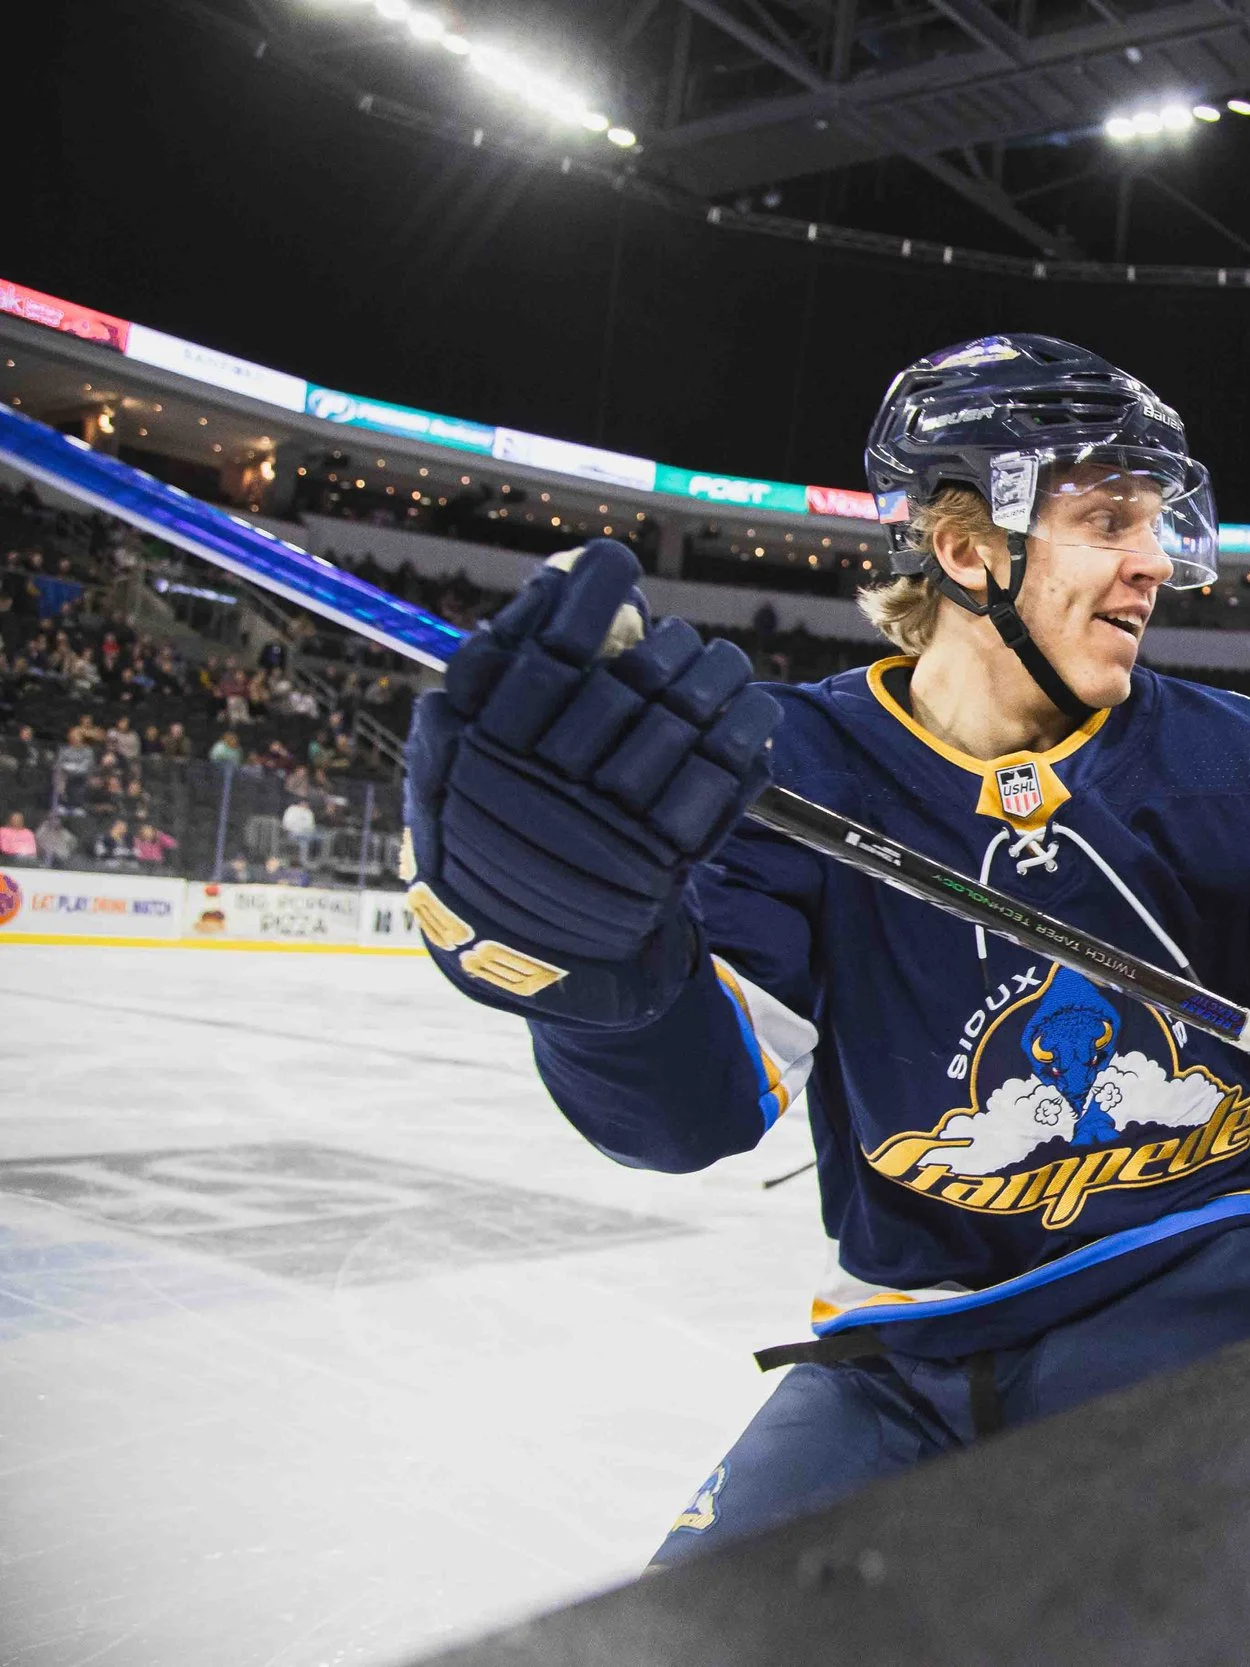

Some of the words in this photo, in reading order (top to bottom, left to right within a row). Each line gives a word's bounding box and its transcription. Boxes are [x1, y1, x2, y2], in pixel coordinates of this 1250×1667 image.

[921, 406, 995, 432] BAUER
[1003, 780, 1036, 796] USHL
[932, 874, 1031, 925] TECHNOLOGY
[1036, 923, 1081, 952] TAPER
[1085, 946, 1137, 980] TWITCH
[947, 966, 1042, 1081] SIOUX
